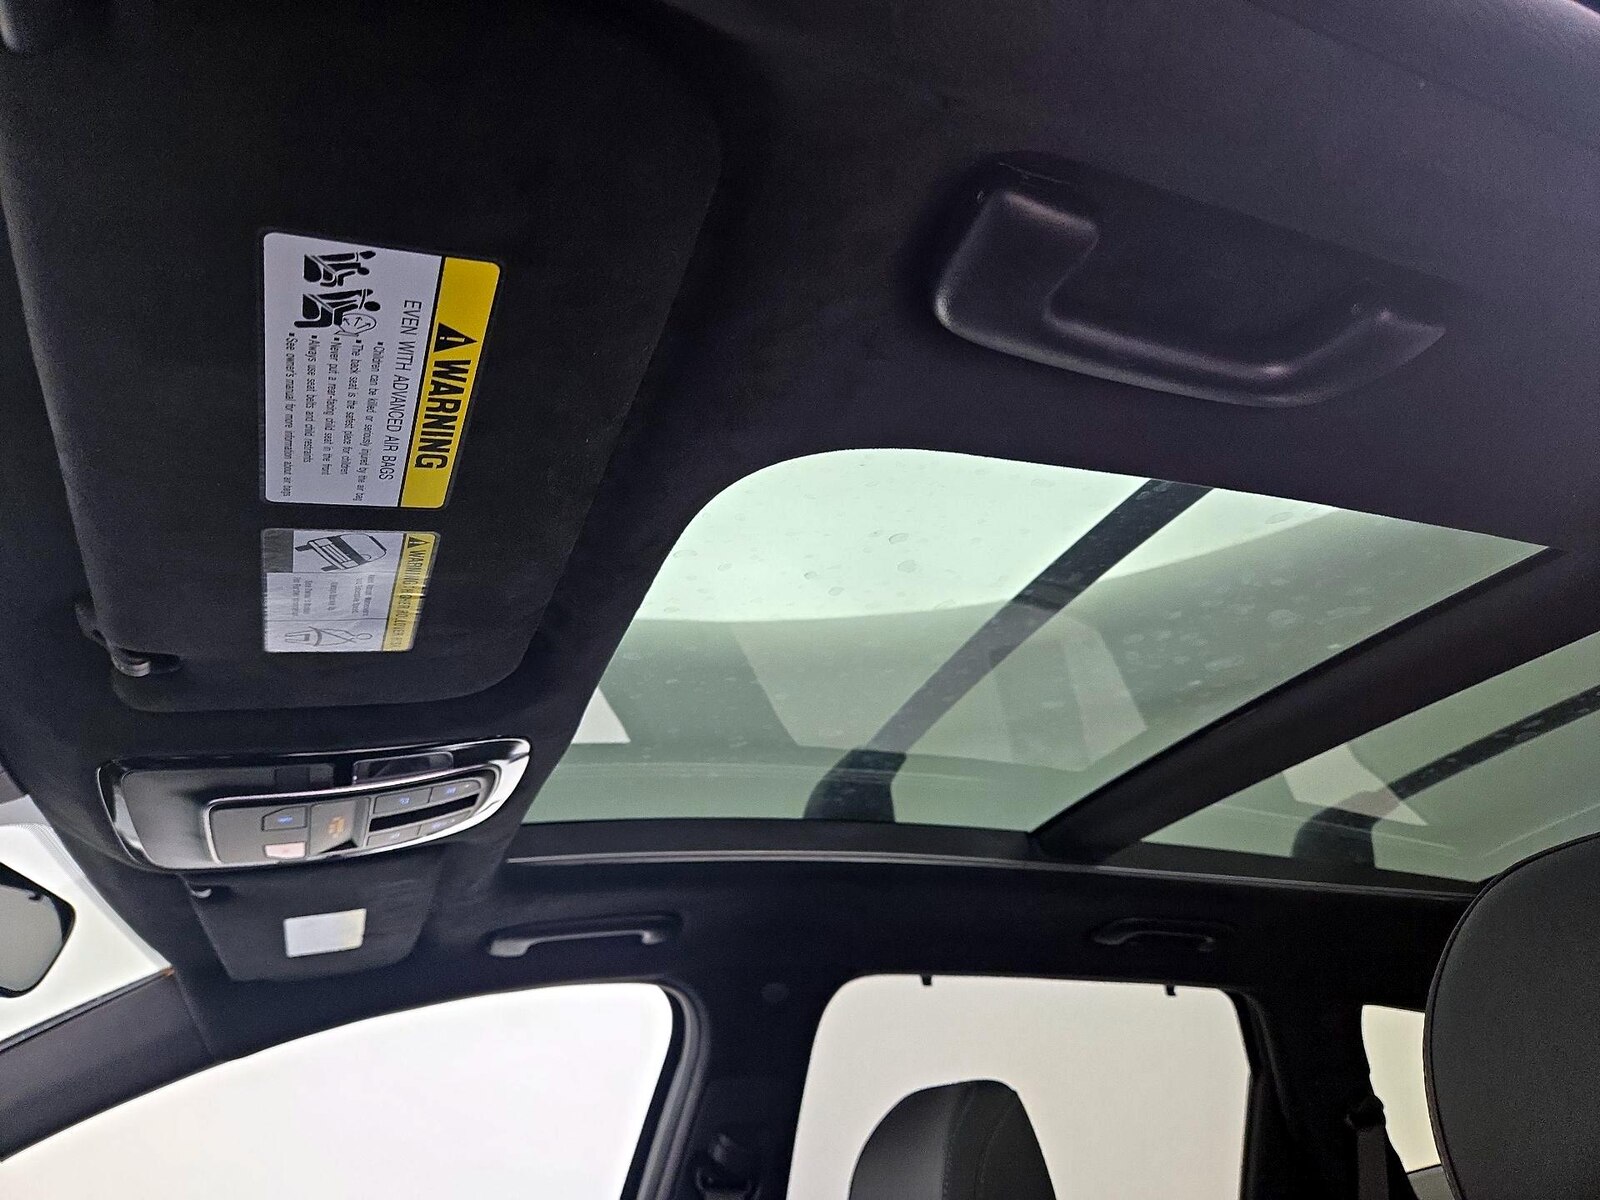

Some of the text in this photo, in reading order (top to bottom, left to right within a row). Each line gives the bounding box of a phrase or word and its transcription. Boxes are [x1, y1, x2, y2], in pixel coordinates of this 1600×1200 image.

[285, 337, 297, 350] See
[304, 338, 320, 362] Always
[329, 341, 341, 361] Never
[351, 344, 363, 356] The
[307, 364, 315, 375] use
[326, 363, 339, 374] put
[306, 378, 317, 392] seat
[348, 376, 359, 389] seat
[369, 374, 378, 385] can
[378, 299, 421, 480] EVEN WITH ADVANCED AIR BAGS
[346, 399, 357, 409] the
[305, 411, 315, 421] and
[414, 357, 471, 469] WARNING
[323, 432, 333, 444] seat
